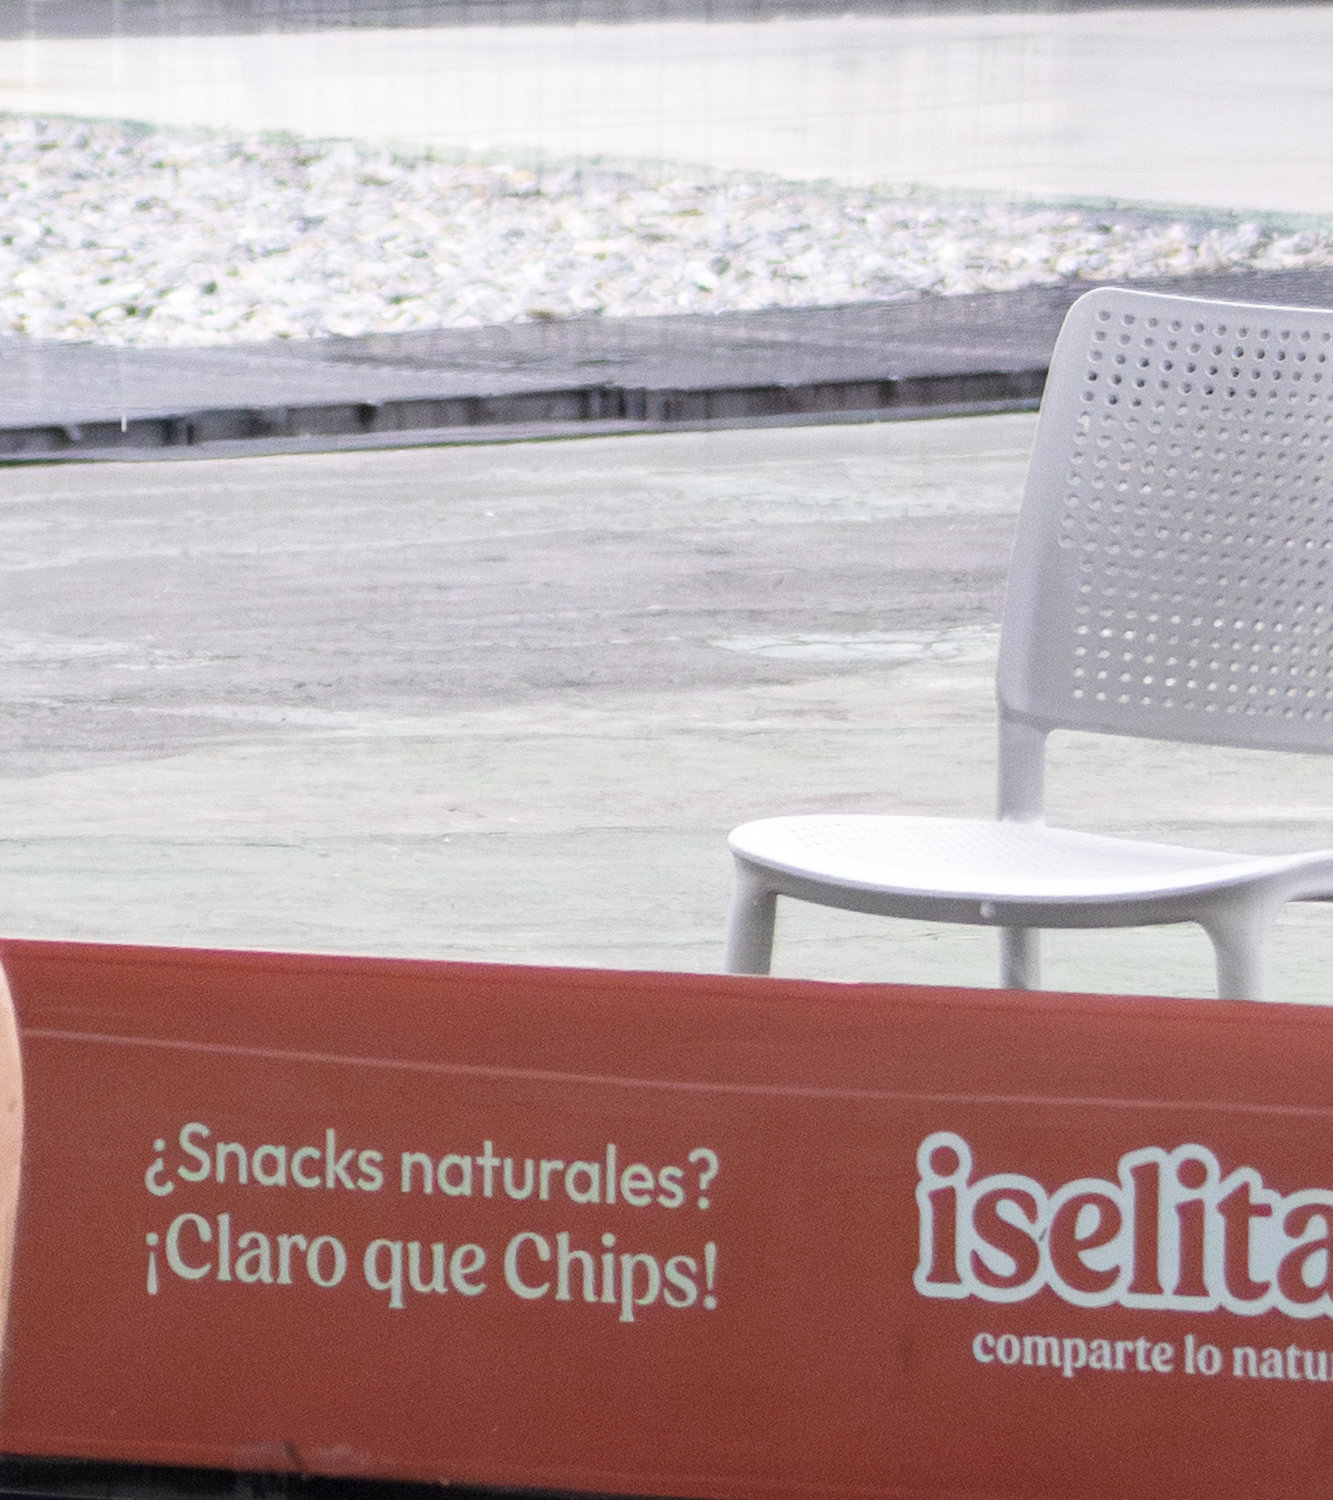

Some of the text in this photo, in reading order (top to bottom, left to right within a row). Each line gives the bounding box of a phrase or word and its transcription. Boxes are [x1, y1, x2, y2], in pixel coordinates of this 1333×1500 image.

[145, 1123, 719, 1209] ¿Snacks naturales?
[146, 1213, 717, 1322] ¡Claro que Chips!
[973, 1333, 1333, 1382] comparte lo natu
